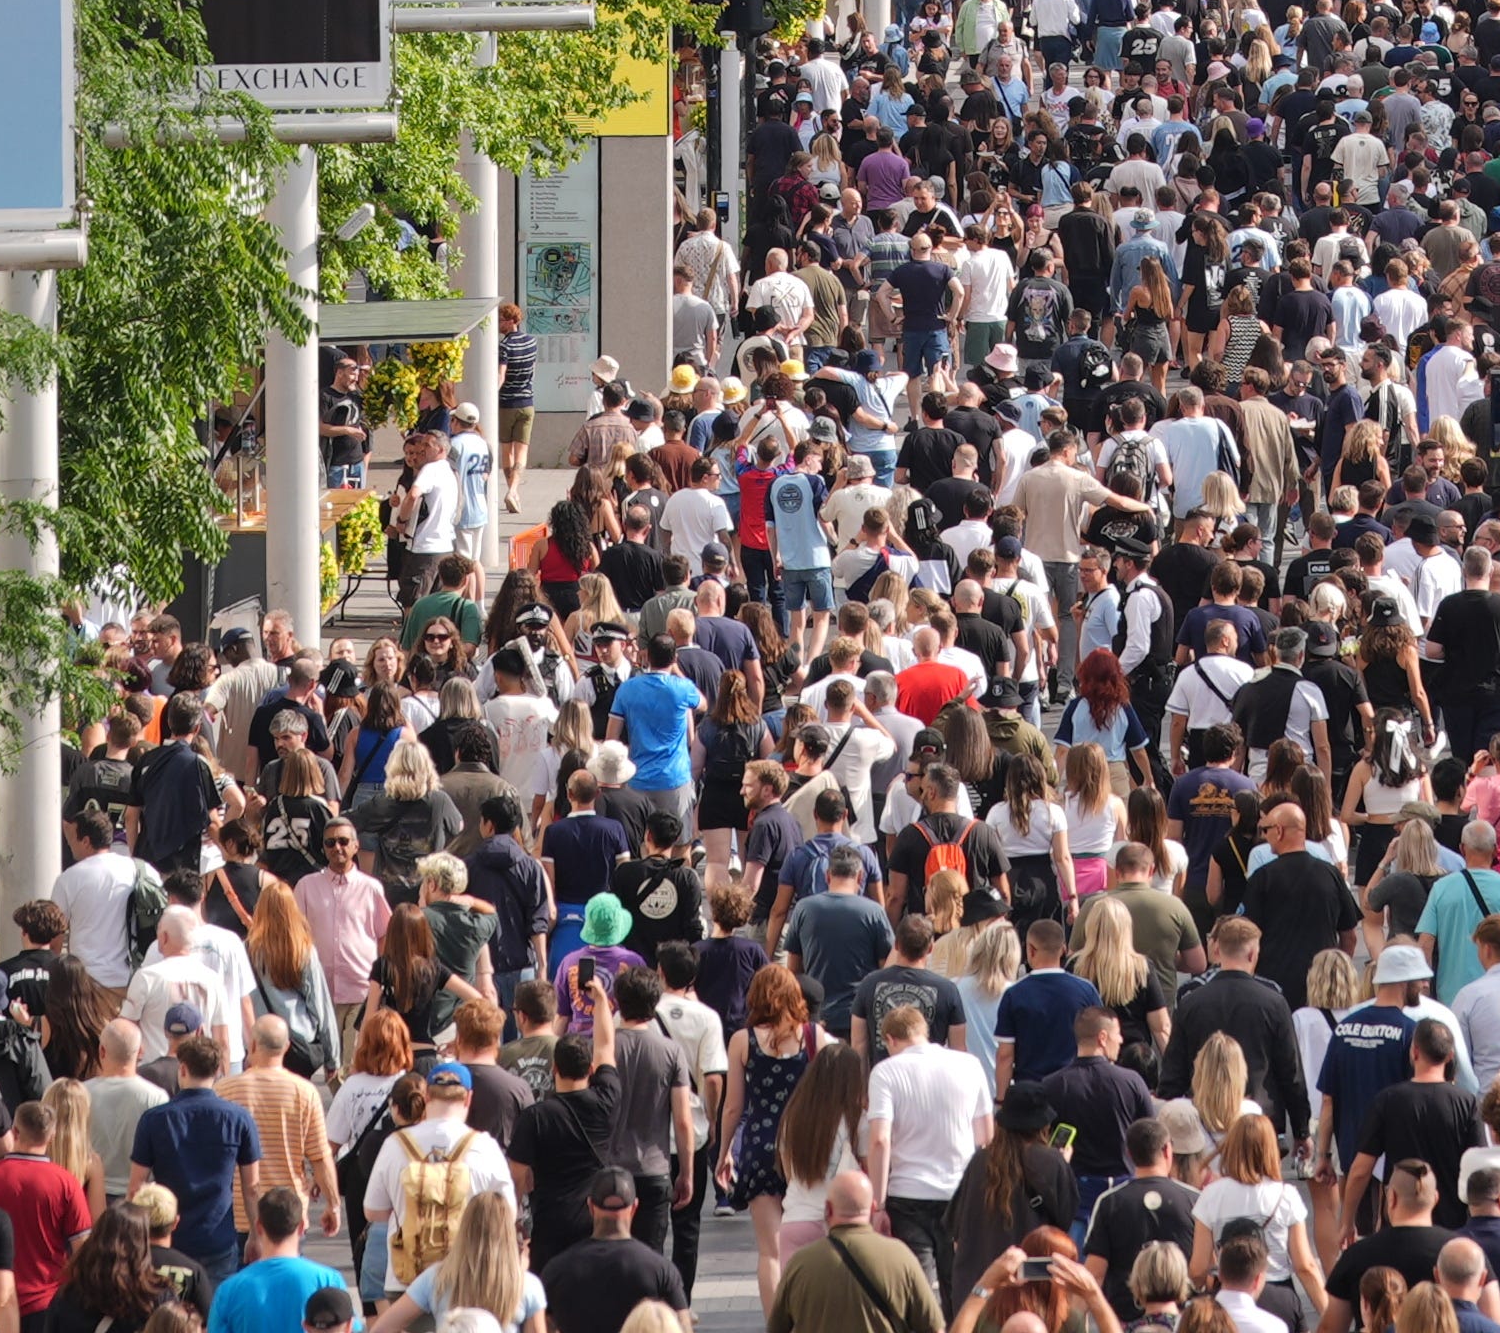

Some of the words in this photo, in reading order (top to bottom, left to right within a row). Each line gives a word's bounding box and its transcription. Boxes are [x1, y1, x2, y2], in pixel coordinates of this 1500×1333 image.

[1131, 38, 1158, 56] 25
[218, 67, 368, 92] EXCHANGE
[266, 817, 311, 851] 25
[1335, 1023, 1361, 1037] COLE
